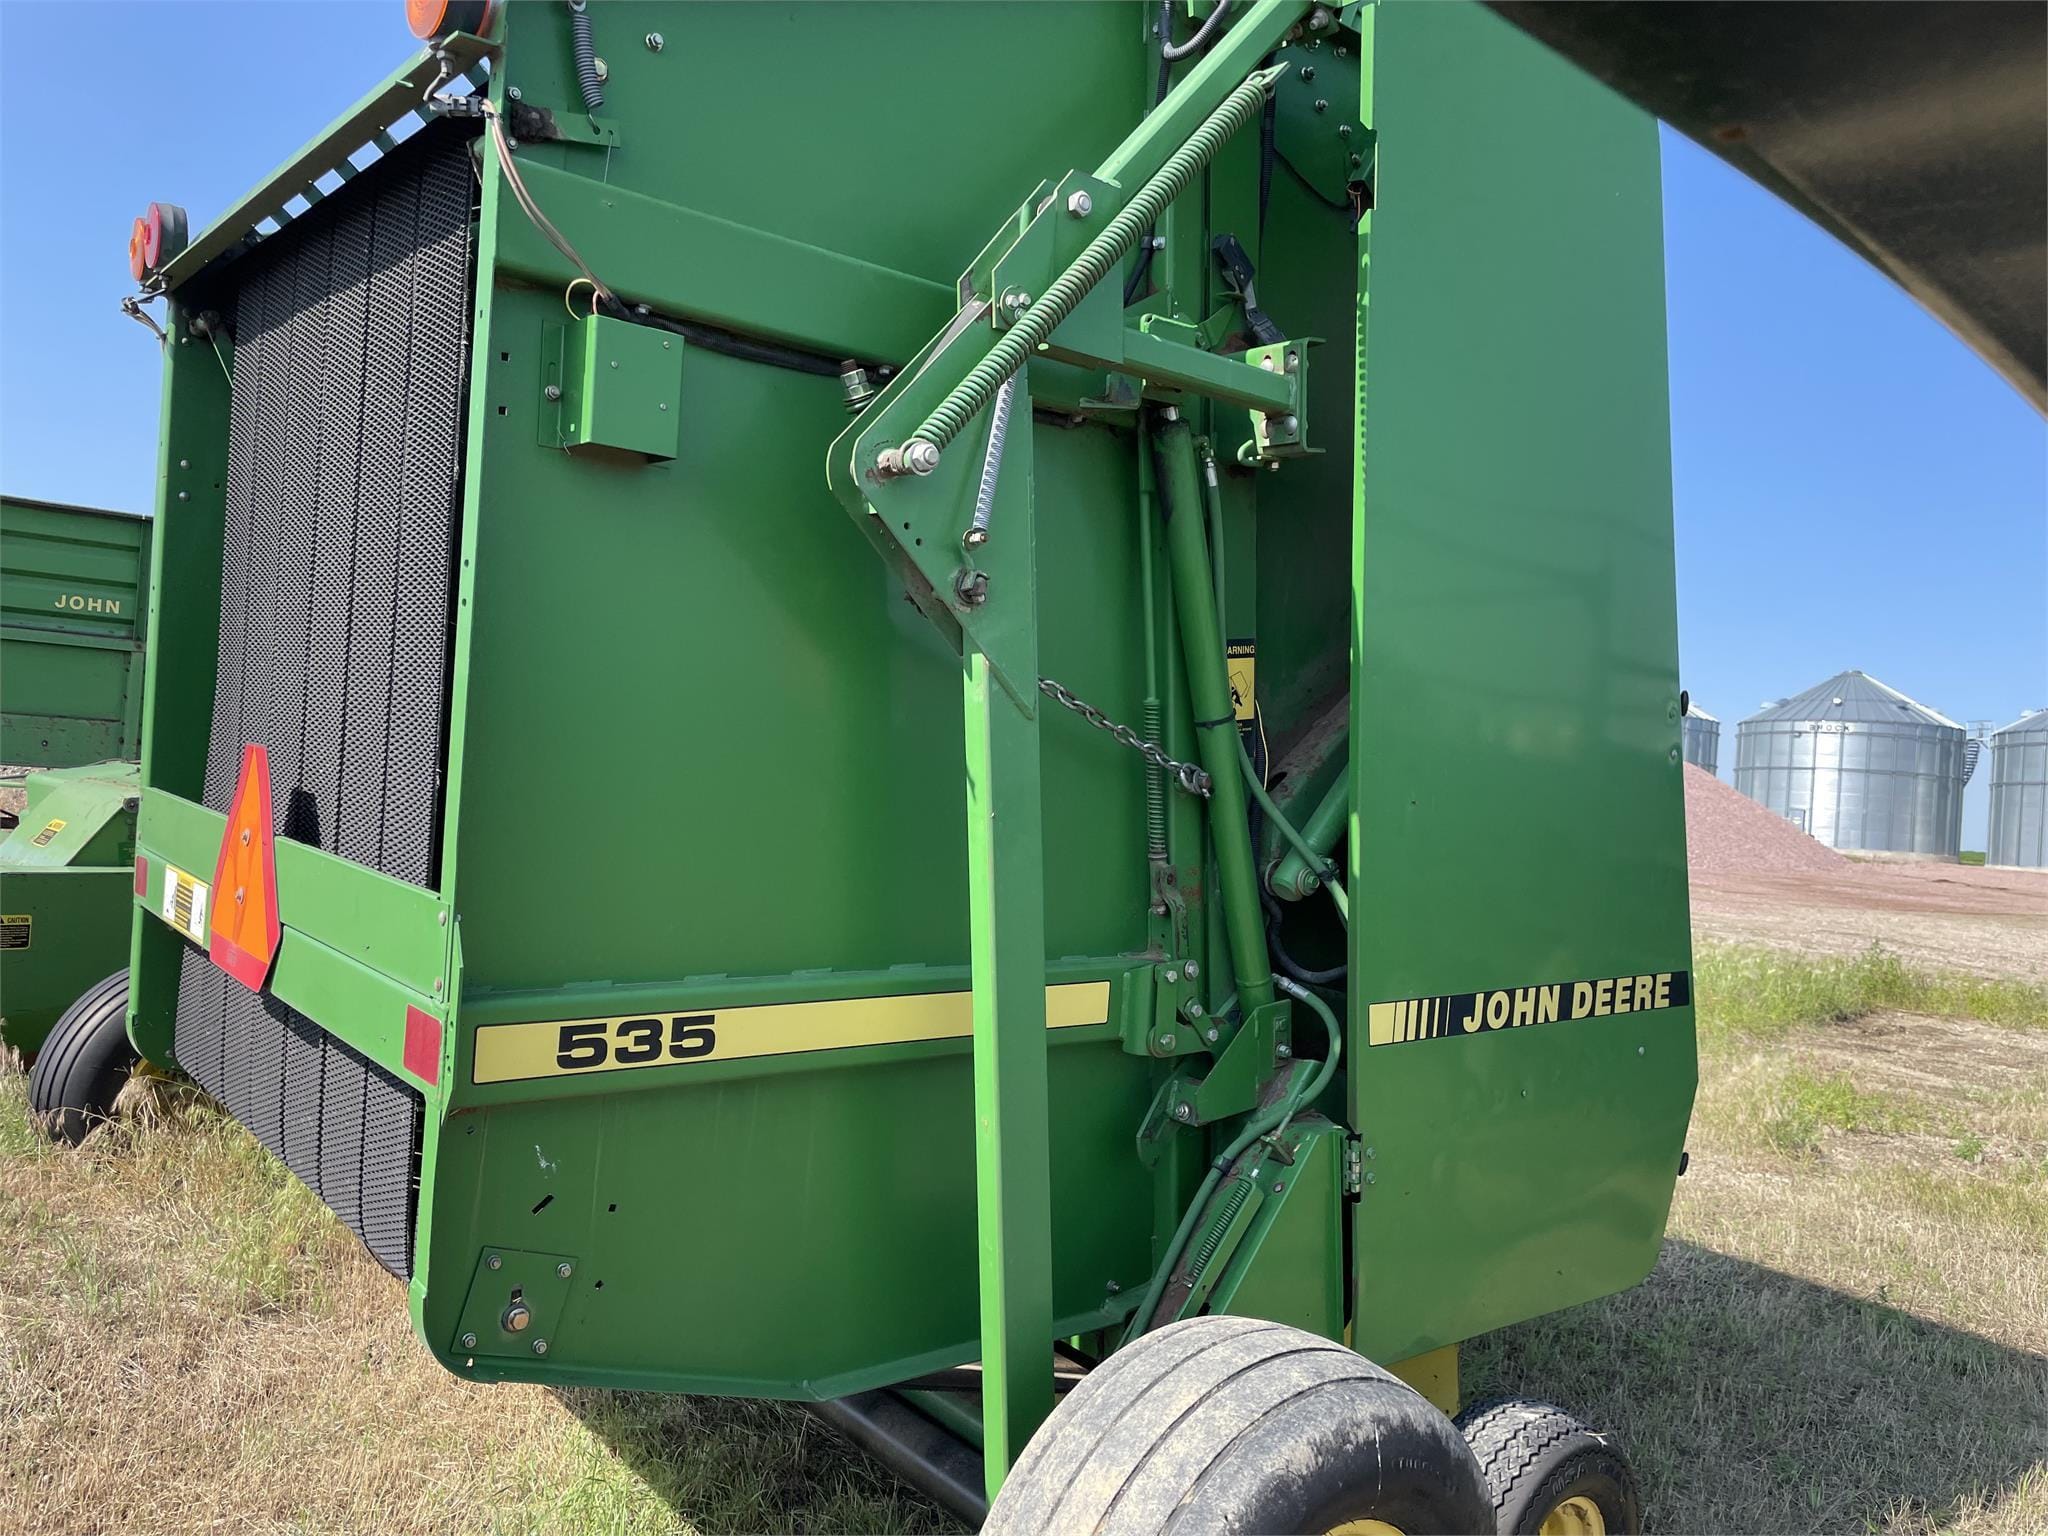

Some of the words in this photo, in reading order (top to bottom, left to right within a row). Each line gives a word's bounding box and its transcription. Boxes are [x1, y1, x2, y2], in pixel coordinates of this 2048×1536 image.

[54, 594, 120, 614] JOHN
[1227, 645, 1255, 655] ARNING
[1463, 984, 1561, 1034] JOHN
[1571, 972, 1672, 1020] DEERE
[556, 1014, 717, 1070] 535
